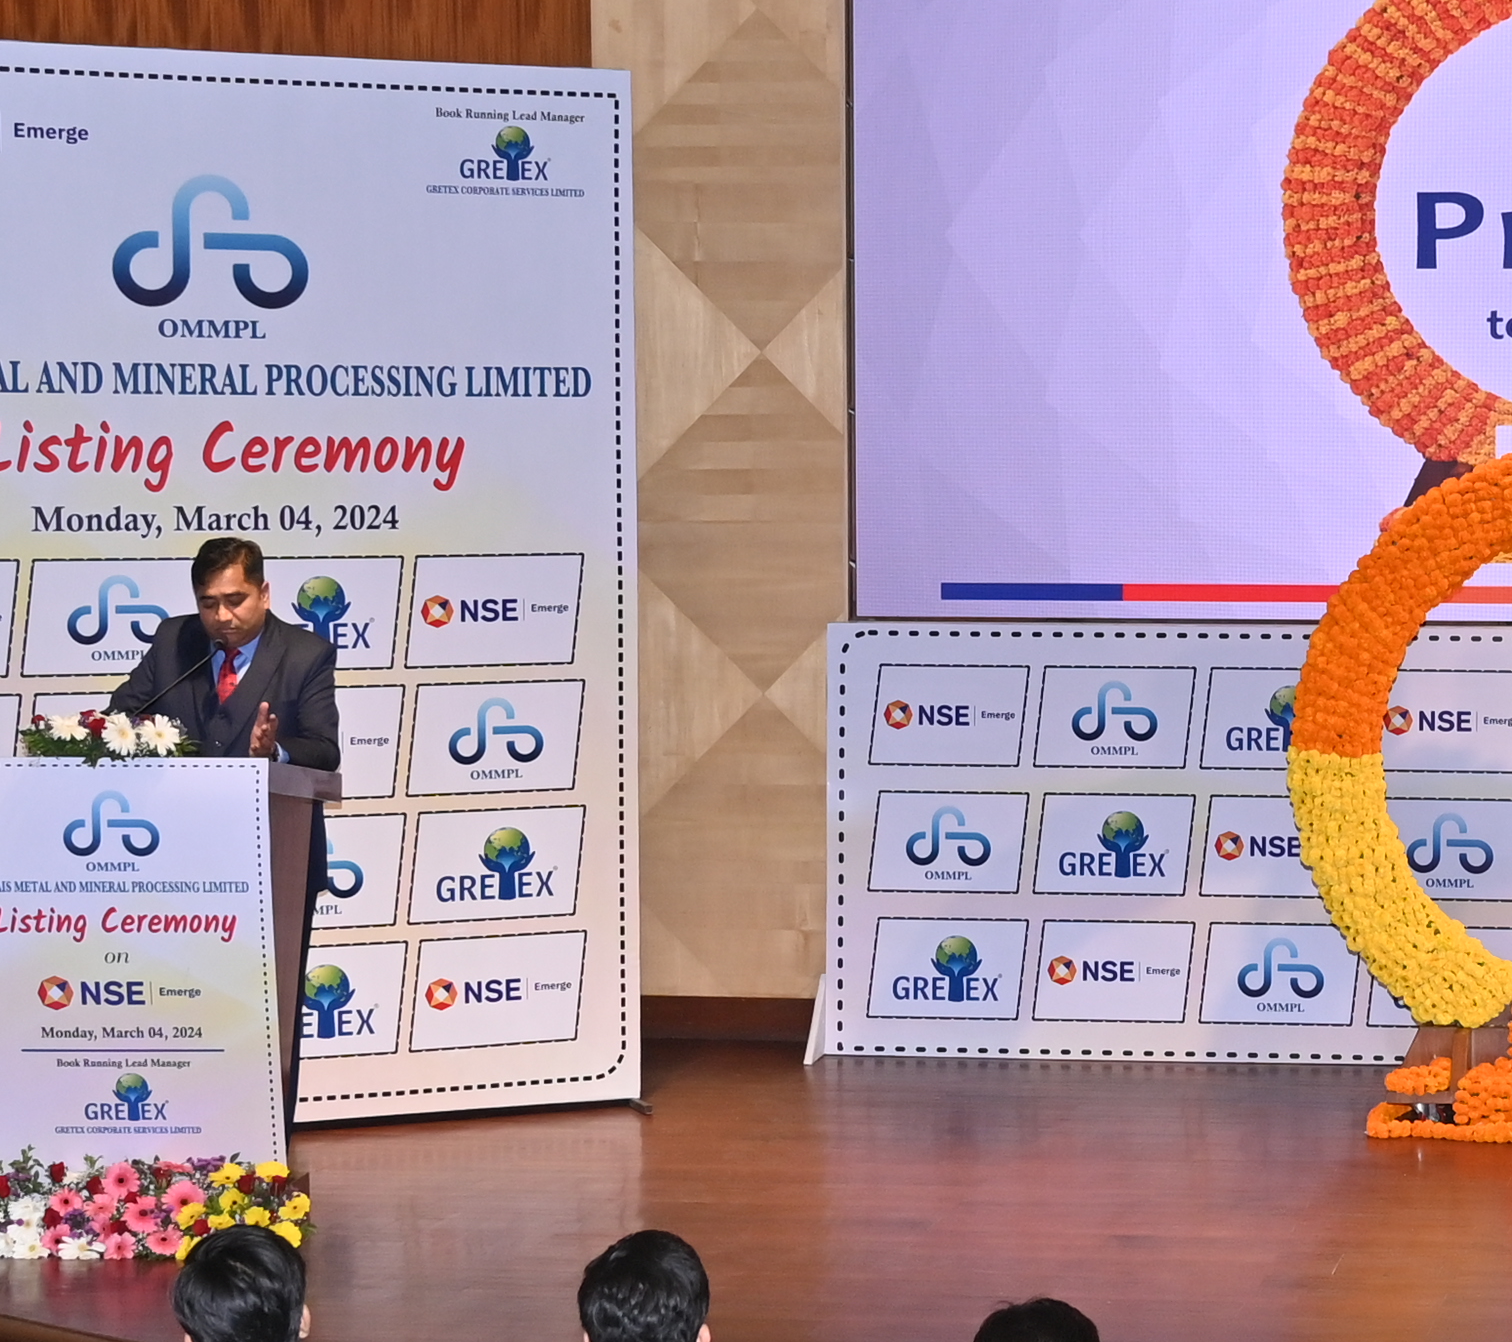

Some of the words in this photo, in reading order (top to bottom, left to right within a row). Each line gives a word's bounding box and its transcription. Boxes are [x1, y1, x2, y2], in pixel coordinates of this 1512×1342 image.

[435, 106, 463, 119] Book
[465, 108, 510, 123] Running
[512, 110, 537, 121] Lead
[540, 110, 585, 125] Manager
[13, 122, 89, 145] Emerge
[460, 144, 548, 181] GRETEX
[425, 184, 460, 195] GRETEX
[460, 185, 510, 196] CORPORATE
[511, 187, 550, 197] SERVICES
[550, 188, 585, 198] LIMITED
[158, 318, 266, 340] OMMPL
[35, 360, 103, 395] AND
[112, 362, 258, 396] MINERAL
[264, 363, 458, 398] PROCESSING
[464, 366, 592, 398] LIMITED
[202, 420, 465, 492] Ceremony
[31, 505, 163, 539] Monday,
[173, 504, 271, 532] March
[279, 504, 322, 538] 04,
[332, 504, 400, 531] 2024
[918, 704, 970, 727] NSE
[980, 710, 1016, 722] Emerge
[1418, 710, 1472, 733] NSE
[85, 861, 140, 872] OMMPL
[436, 851, 554, 902] GRETEX
[14, 880, 52, 893] METAL
[53, 880, 77, 893] AND
[78, 880, 130, 893] MINERAL
[131, 880, 201, 893] PROCESSING
[202, 881, 250, 893] LIMITED
[1425, 878, 1475, 889] OMMPL
[101, 906, 237, 943] Ceremony
[105, 951, 129, 964] on
[80, 980, 146, 1006] NSE
[158, 986, 202, 999] Emerge
[1256, 1002, 1305, 1013] OMMPL
[40, 1026, 98, 1042] Monday,
[101, 1026, 145, 1039] March
[147, 1026, 169, 1041] 04,
[172, 1026, 203, 1039] 2024
[56, 1058, 81, 1068] Book
[82, 1058, 123, 1070] Running
[125, 1058, 149, 1068] Lead
[150, 1058, 191, 1070] Manager
[85, 1089, 166, 1121] GRETEX
[54, 1126, 86, 1134] GRETEX
[86, 1126, 133, 1134] CORPORATE
[133, 1126, 169, 1134] SERVICES
[169, 1126, 202, 1134] LIMITED
